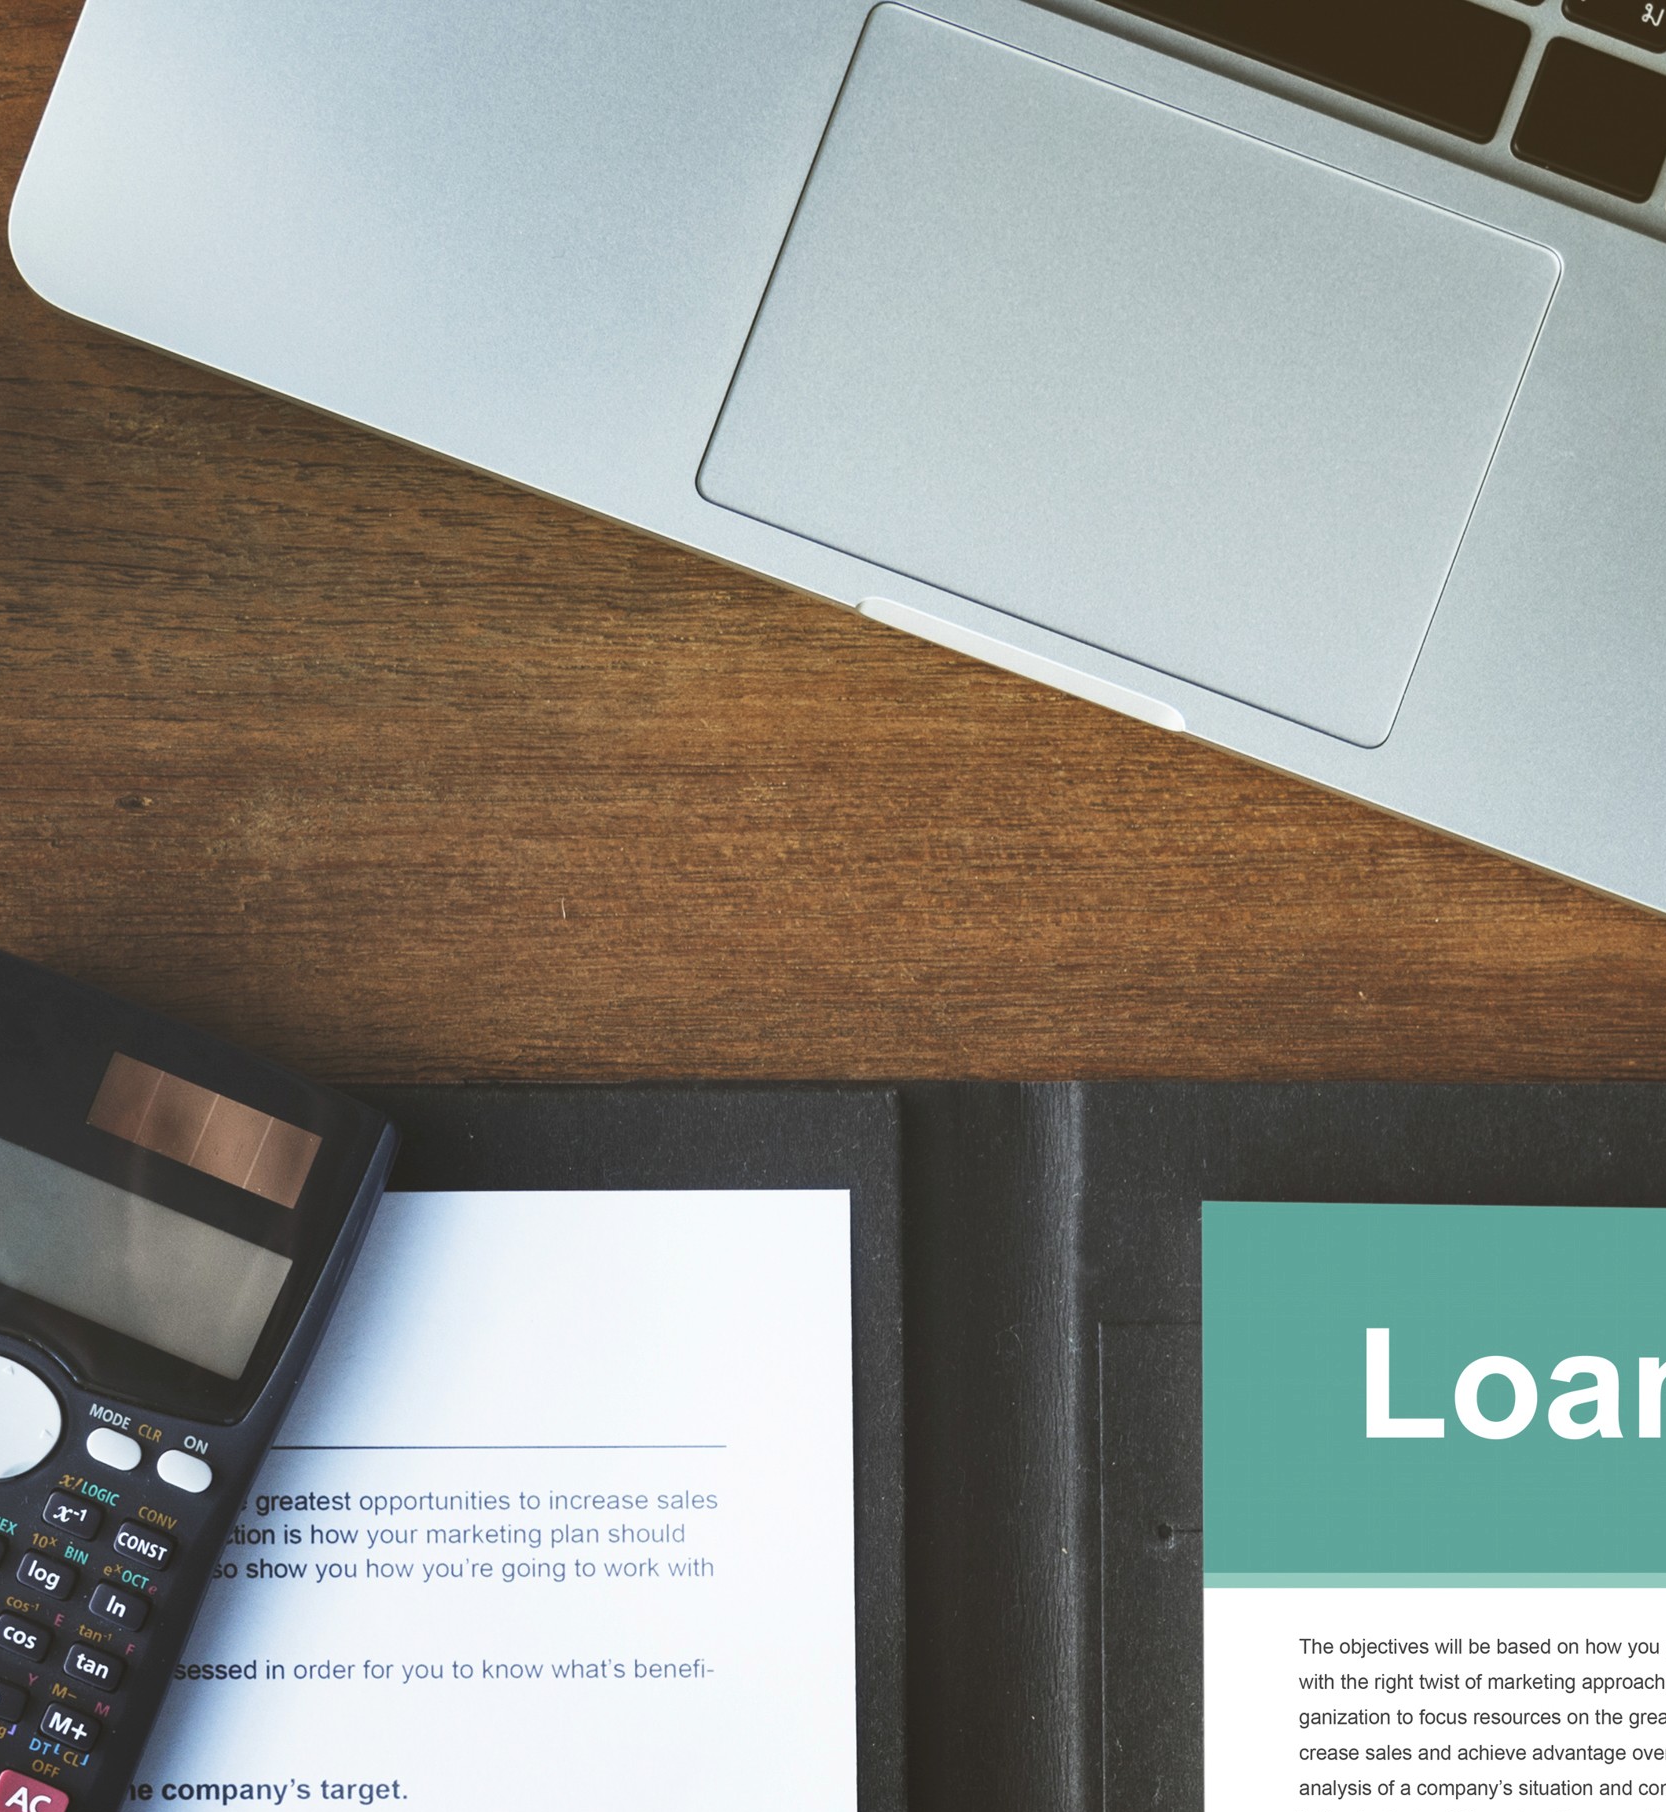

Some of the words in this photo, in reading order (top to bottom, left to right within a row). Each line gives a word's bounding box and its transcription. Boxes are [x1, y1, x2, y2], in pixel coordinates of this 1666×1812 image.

[89, 1403, 131, 1431] MODE
[138, 1423, 162, 1443] CLR
[183, 1435, 208, 1455] ON
[81, 1481, 120, 1506] LOGIC
[255, 1490, 352, 1513] greatest
[359, 1490, 511, 1516] opportunities
[519, 1491, 541, 1510] to
[549, 1490, 649, 1510] increase
[657, 1489, 718, 1509] sales
[138, 1506, 177, 1529] CONV
[117, 1532, 168, 1562] CONST
[27, 1560, 60, 1591] log
[105, 1595, 126, 1619] ln
[2, 1626, 38, 1650] cos
[1299, 1639, 1333, 1654] The
[1340, 1639, 1428, 1658] objectives
[1435, 1639, 1461, 1654] will
[1470, 1639, 1490, 1654] be
[1498, 1639, 1550, 1654] based
[1558, 1642, 1578, 1654] on
[1586, 1639, 1622, 1654] how
[1628, 1642, 1659, 1658] you
[76, 1652, 109, 1679] tan
[161, 1778, 312, 1806] company’s
[320, 1779, 408, 1805] target.
